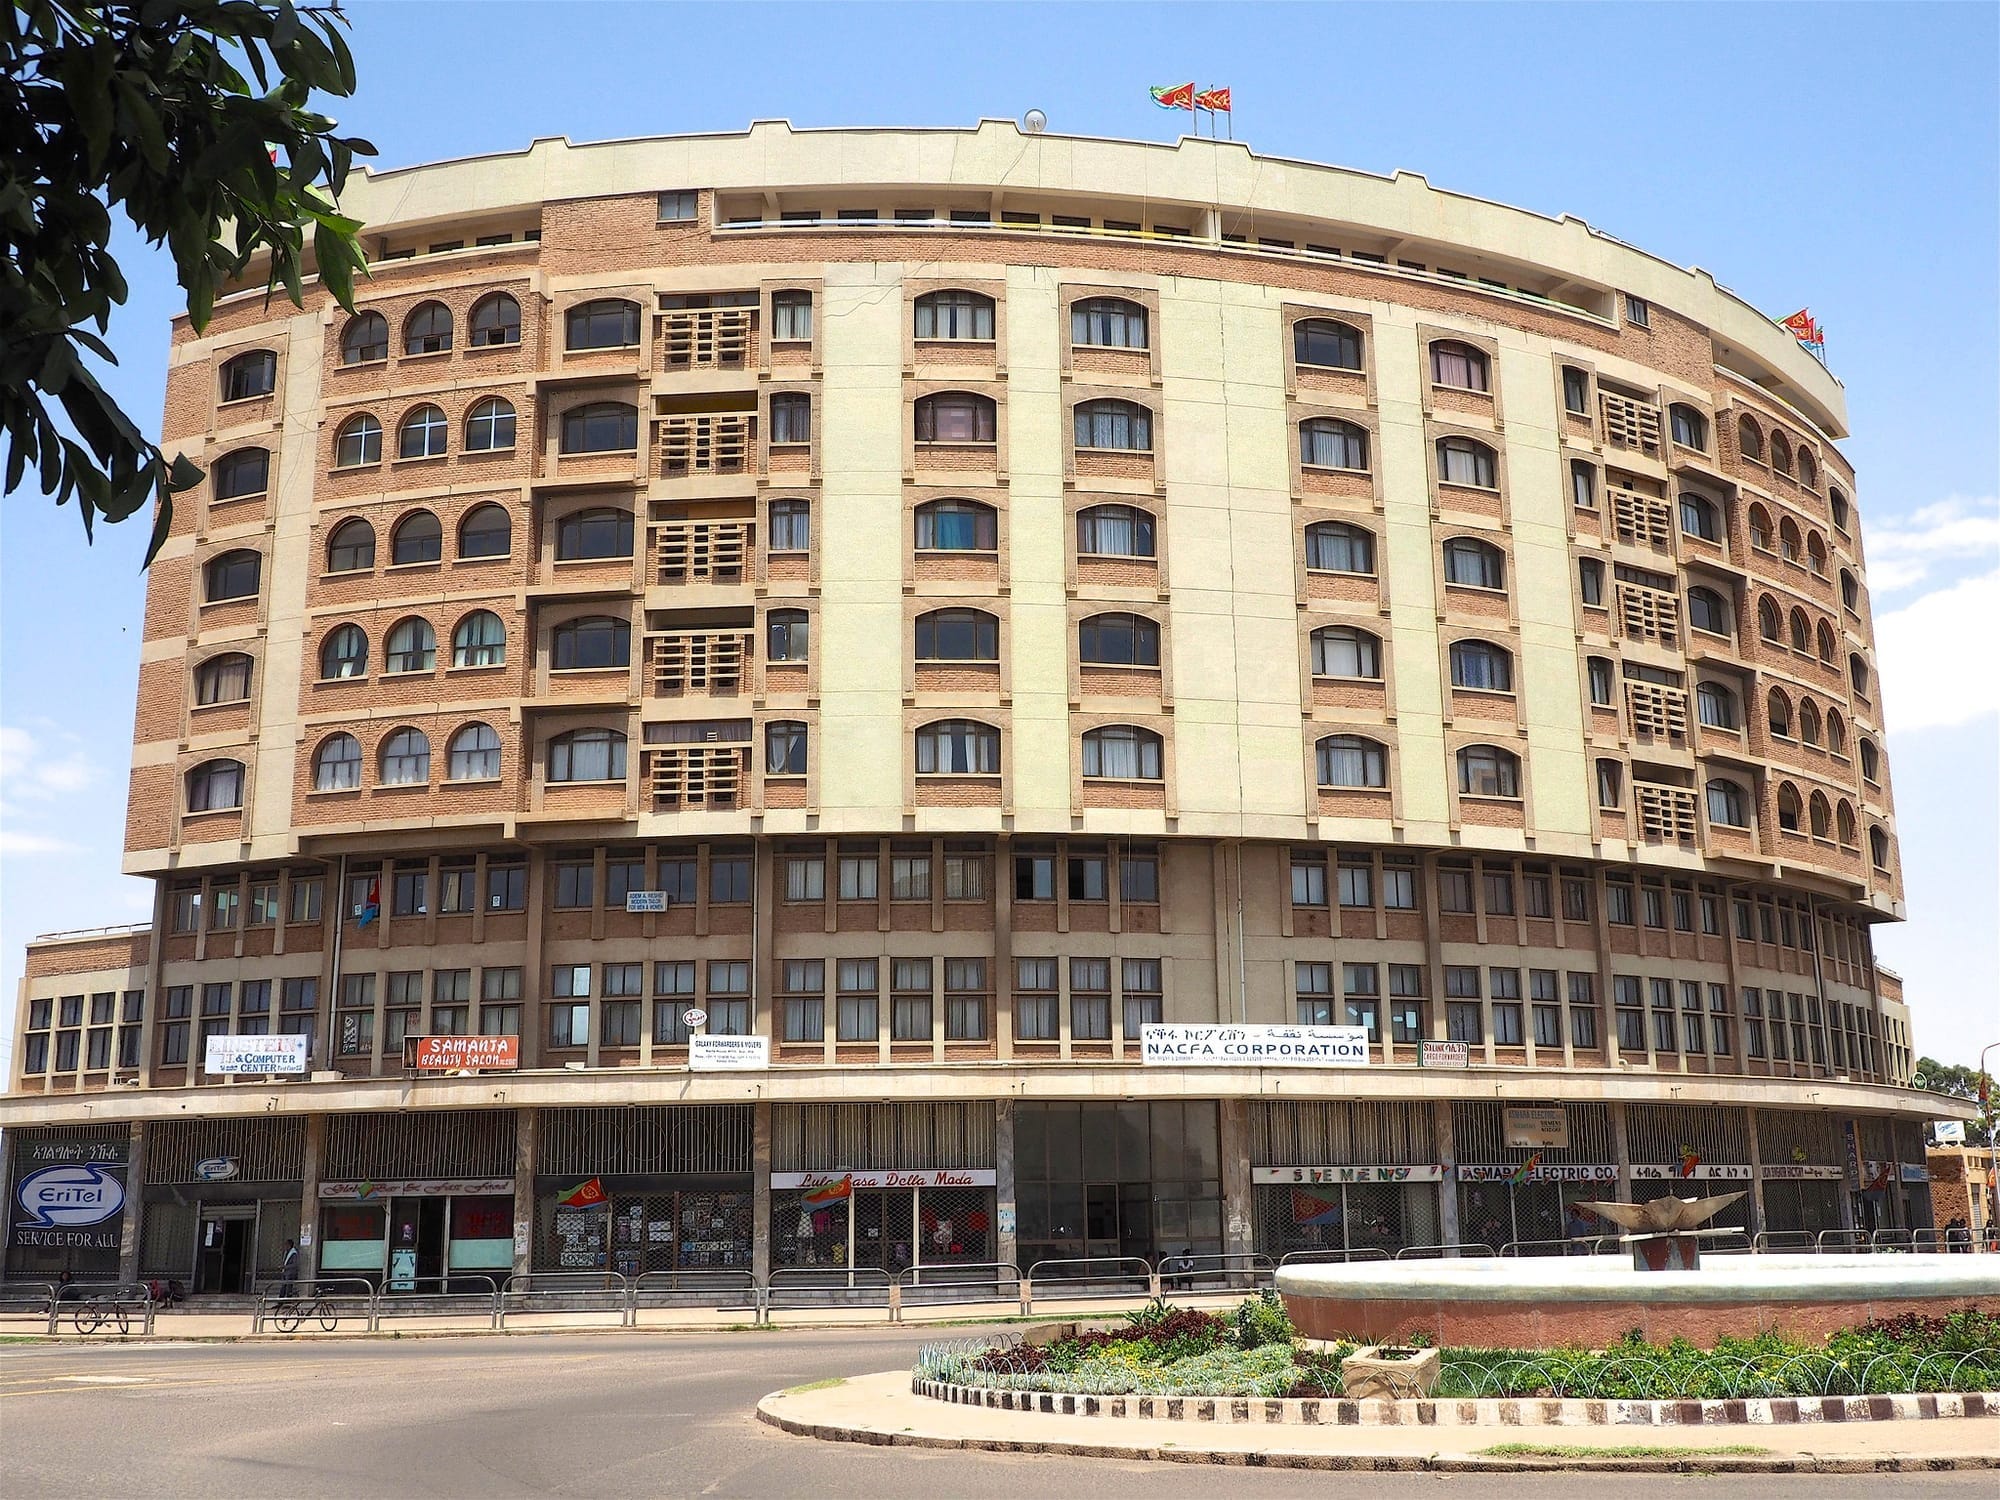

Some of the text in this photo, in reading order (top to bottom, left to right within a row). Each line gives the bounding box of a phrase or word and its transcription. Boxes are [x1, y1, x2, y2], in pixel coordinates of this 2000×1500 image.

[431, 1039, 508, 1054] SAMANTA
[1147, 1043, 1364, 1056] NACFA CORPORATION
[235, 1054, 244, 1063] &
[421, 1054, 461, 1067] BEAUTY
[465, 1054, 499, 1066] SALON
[240, 1063, 277, 1073] CENTER
[886, 1172, 927, 1186] Della
[934, 1171, 973, 1185] Moda
[1462, 1167, 1521, 1180] ASMAR
[1595, 1167, 1616, 1179] CO.
[464, 1181, 511, 1194] Food
[39, 1187, 103, 1203] EriTel
[17, 1230, 118, 1248] SERVICE FOR ALL
